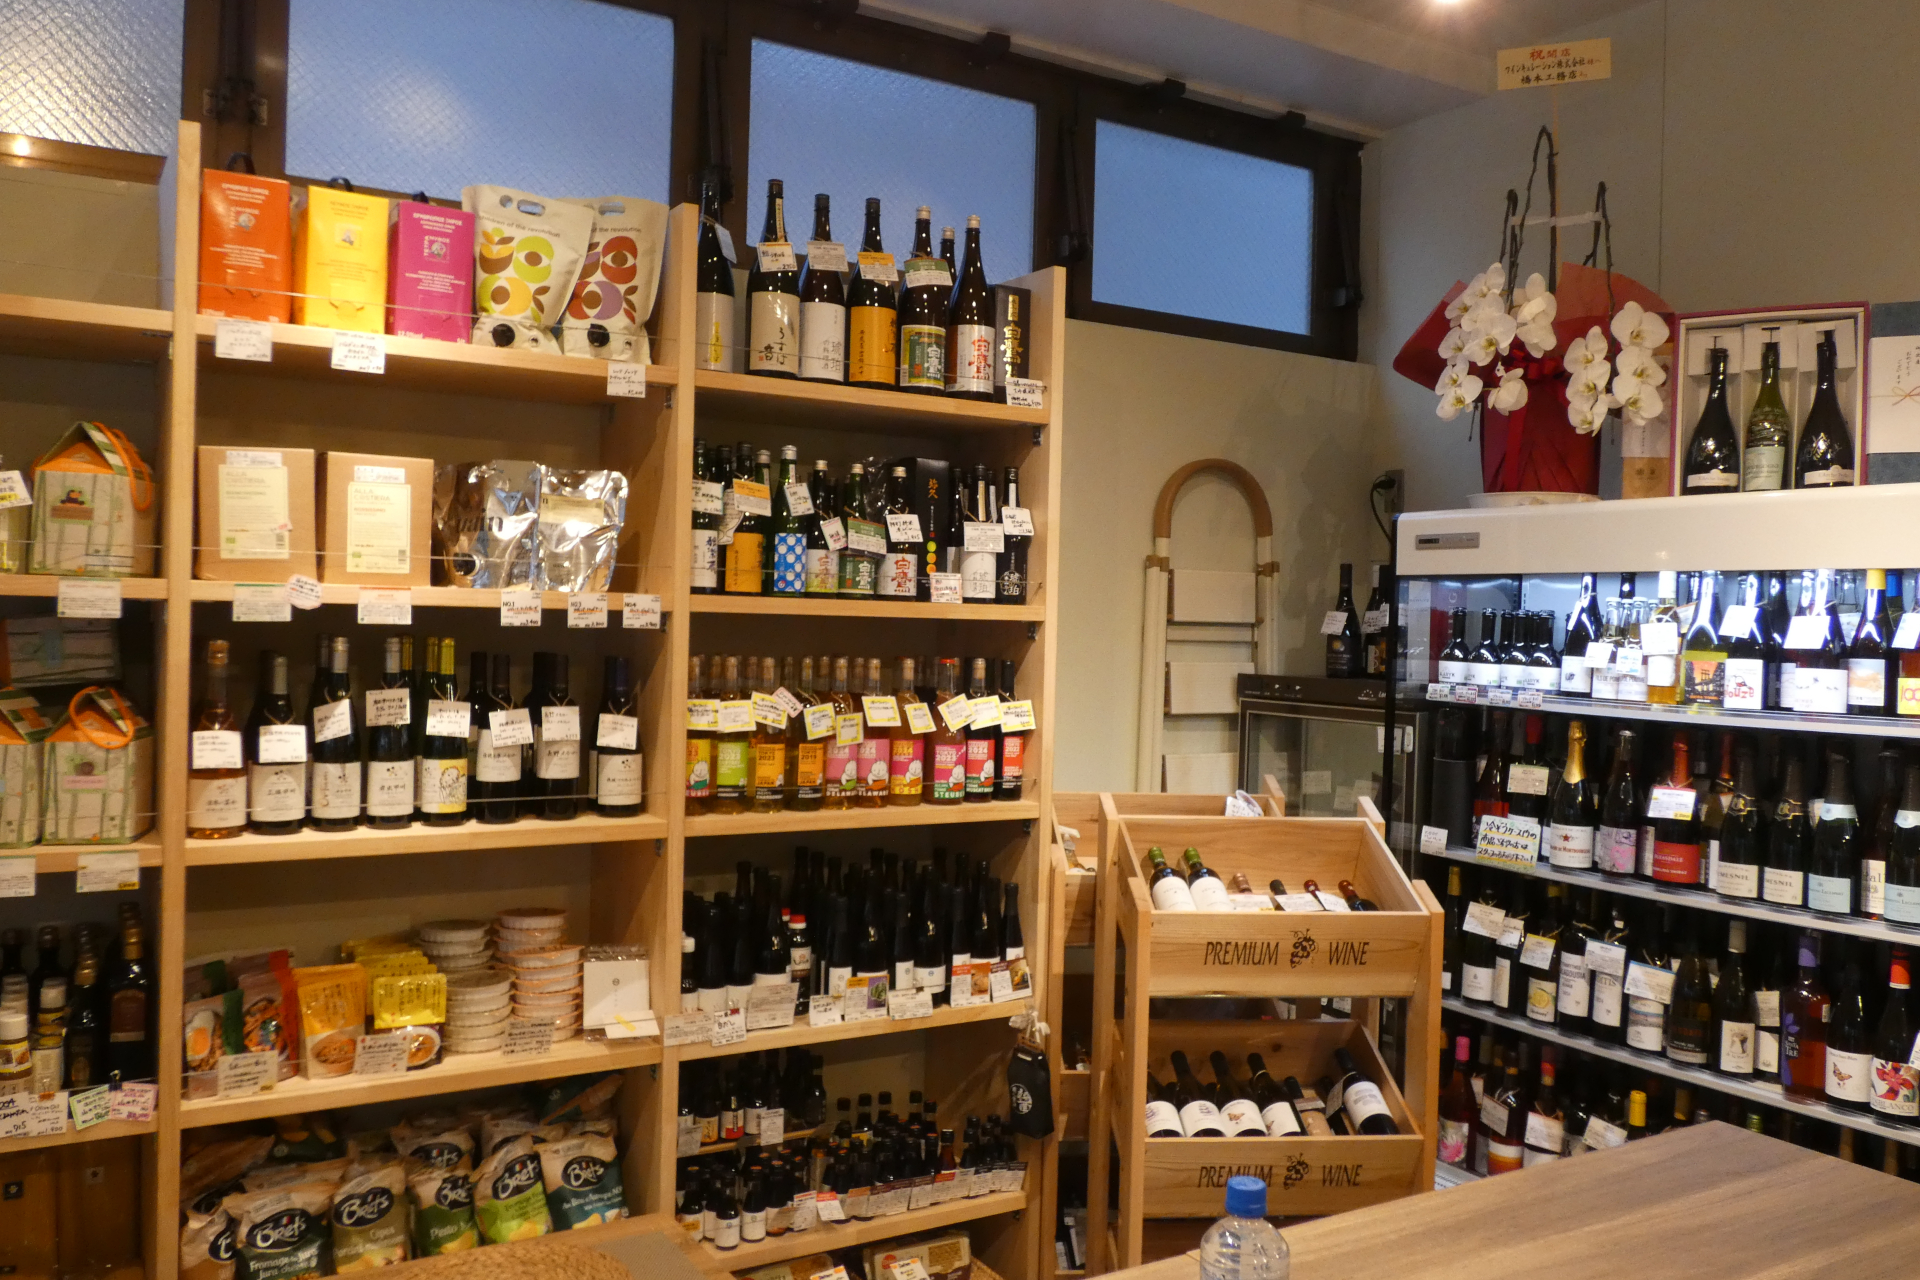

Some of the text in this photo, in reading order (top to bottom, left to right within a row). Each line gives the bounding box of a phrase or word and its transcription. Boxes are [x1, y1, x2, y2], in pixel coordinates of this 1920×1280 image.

[1204, 942, 1370, 966] PREMIUM WINE
[568, 1163, 605, 1187] Brets
[1322, 1164, 1363, 1188] WINE
[340, 1194, 390, 1225] Brets
[253, 1215, 306, 1248] Brets
[430, 1225, 458, 1240] Pesto
